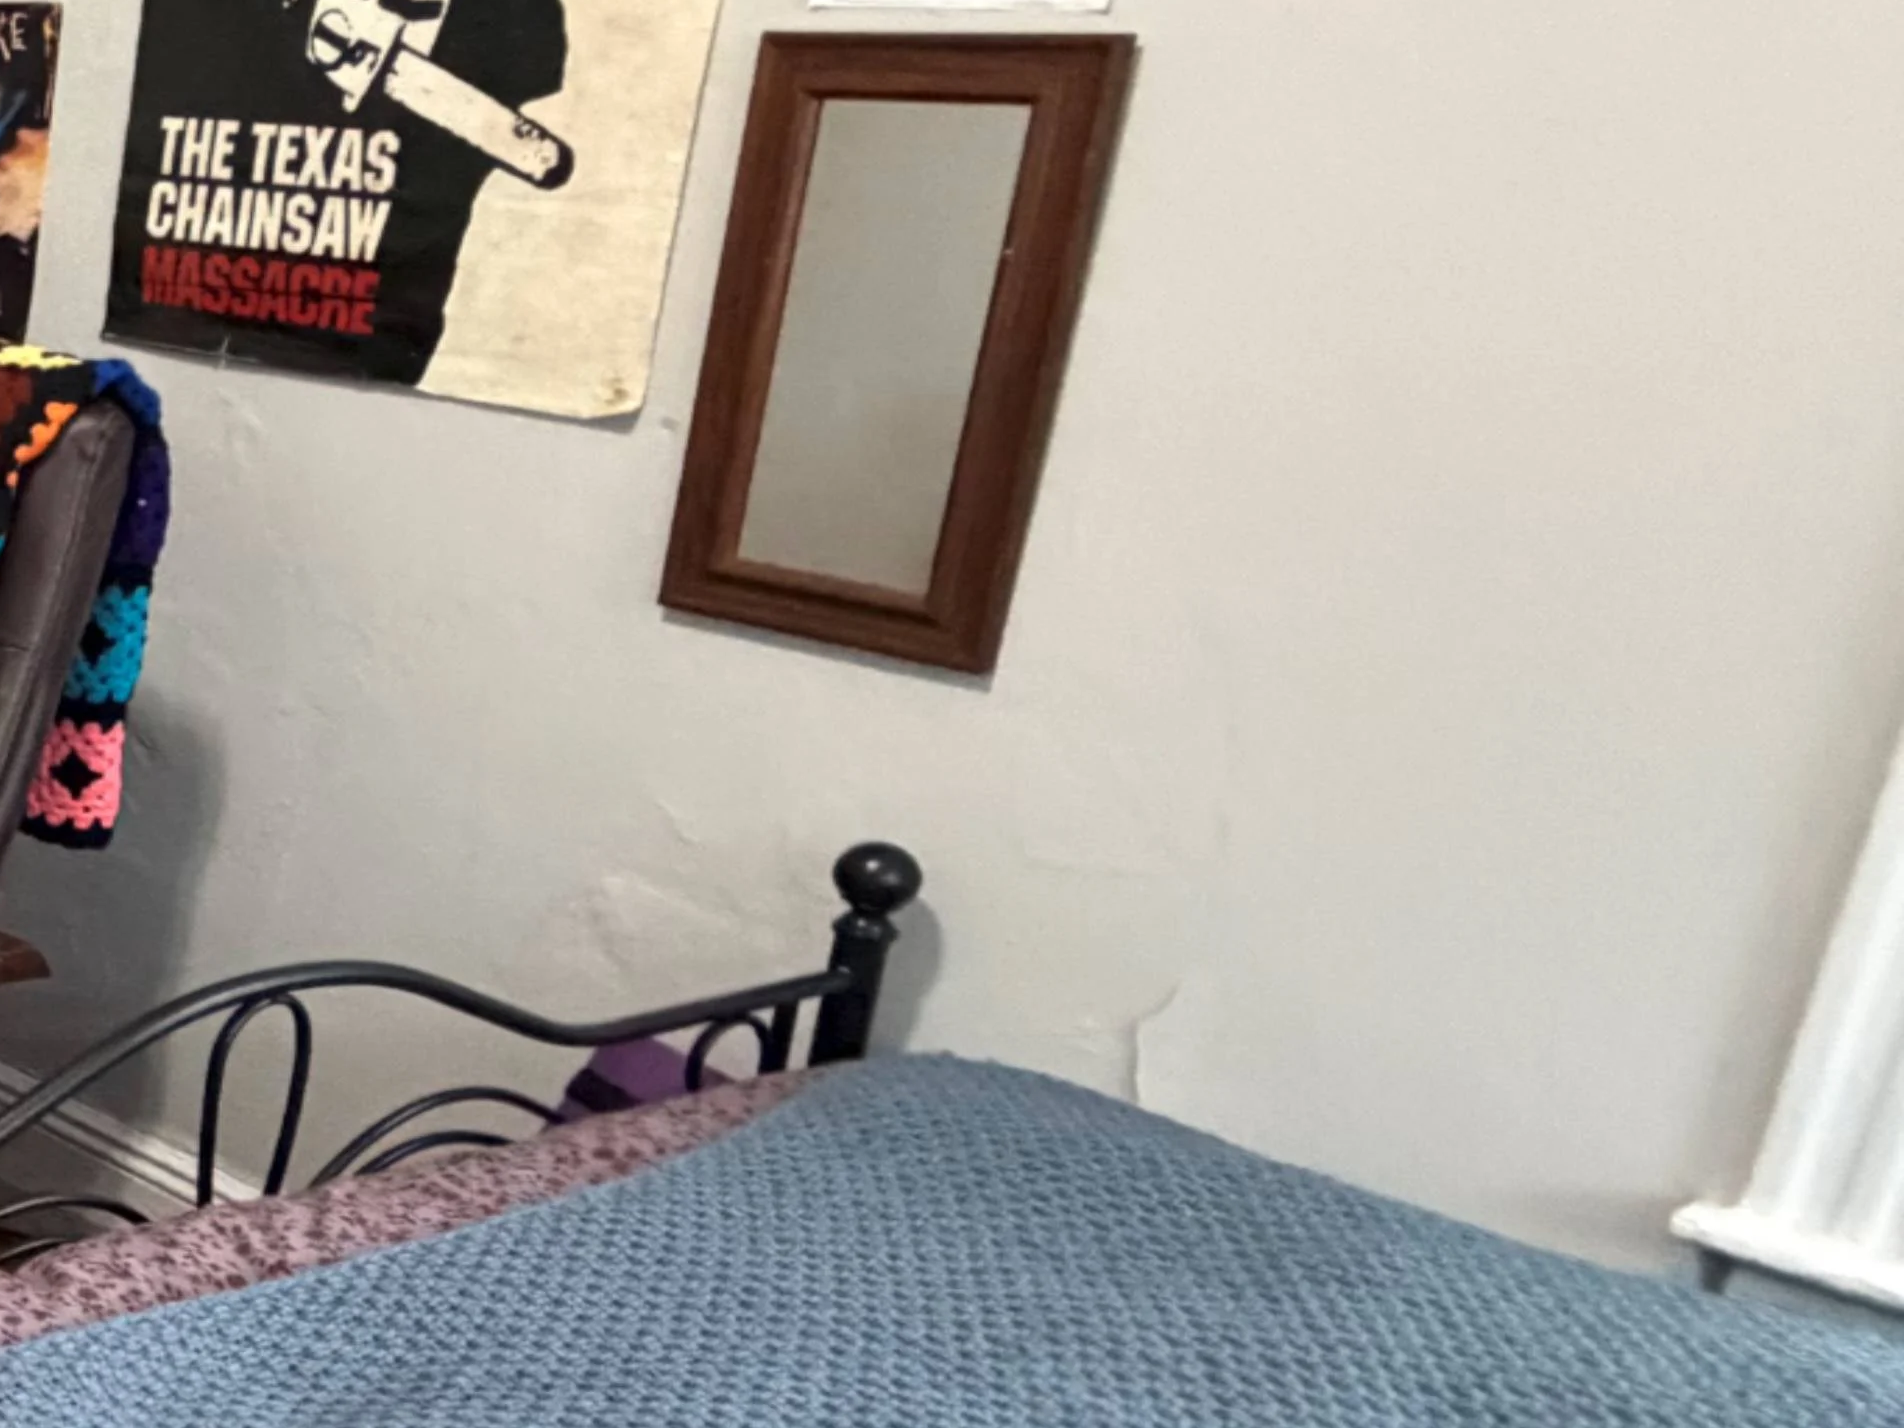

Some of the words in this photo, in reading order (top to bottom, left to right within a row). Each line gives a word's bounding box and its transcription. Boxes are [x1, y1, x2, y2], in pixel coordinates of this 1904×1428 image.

[160, 116, 240, 181] THE
[250, 122, 401, 194] TEXAS
[146, 180, 392, 262] CHAINSAW
[143, 245, 380, 335] MASSACRE
